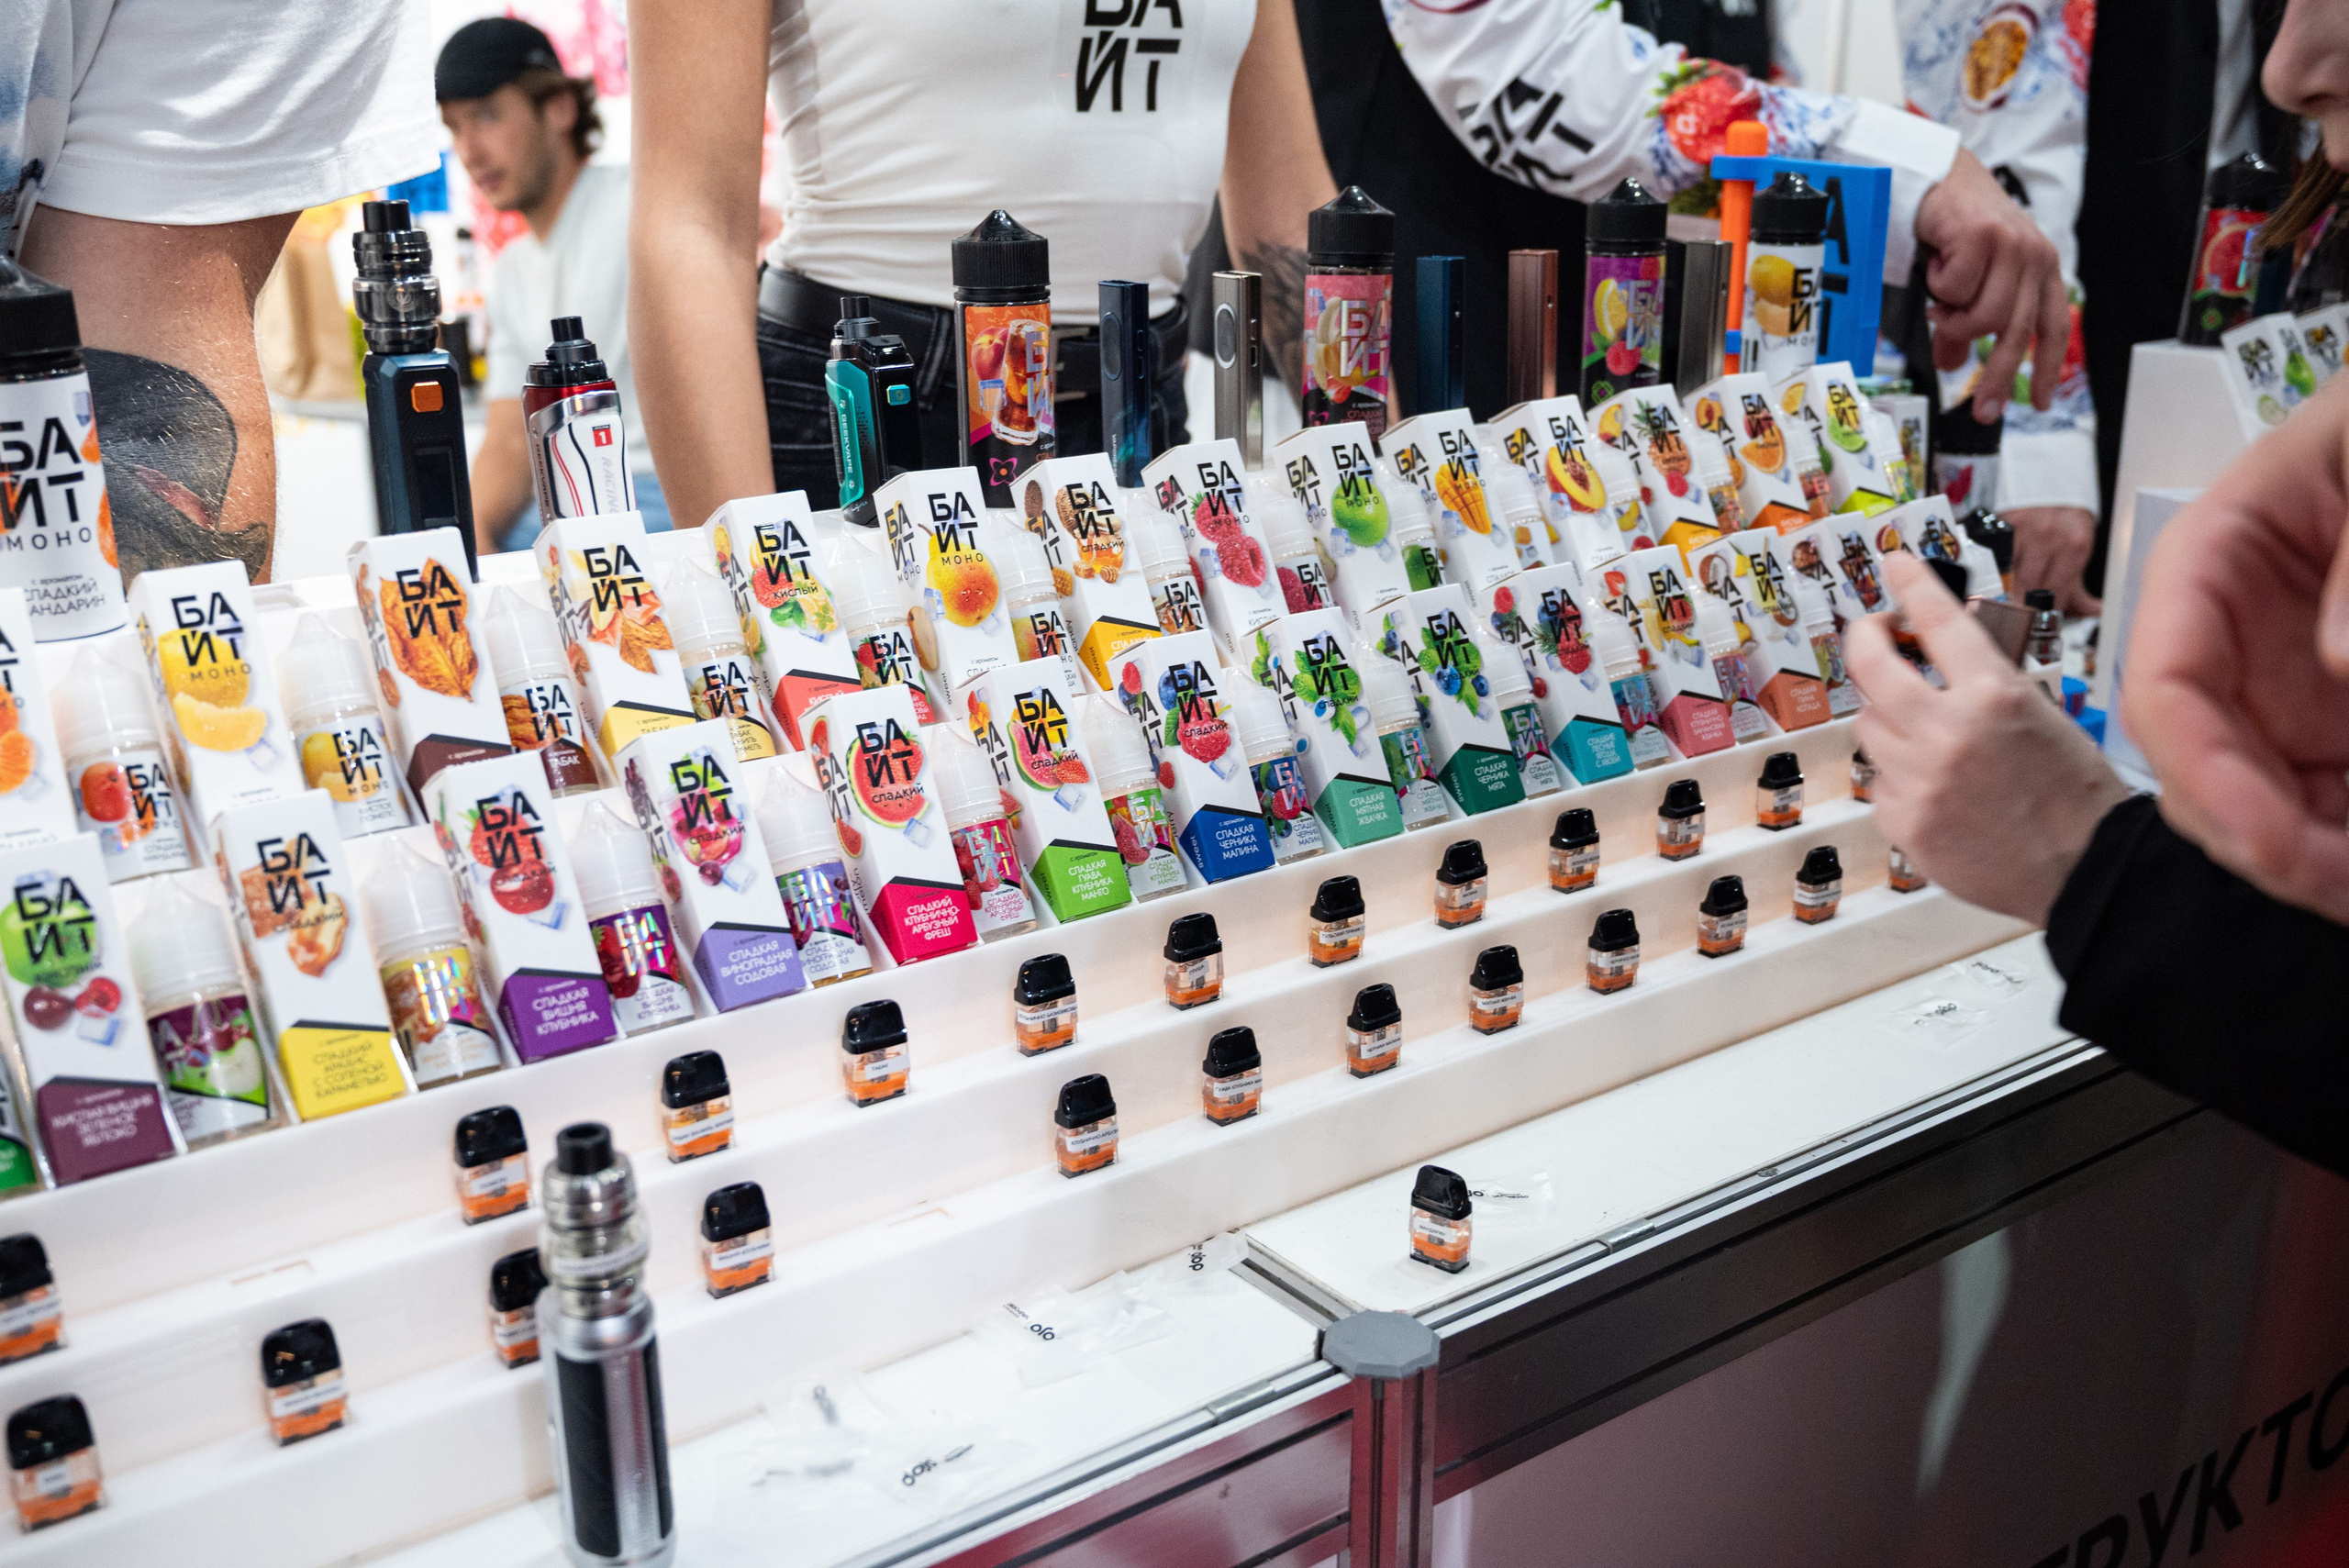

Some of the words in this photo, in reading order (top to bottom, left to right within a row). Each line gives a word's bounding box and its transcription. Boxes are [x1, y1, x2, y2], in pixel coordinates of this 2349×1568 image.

[1548, 415, 1584, 440] БА
[841, 414, 853, 474] GEEKVAPE
[1438, 428, 1475, 456] БА
[1331, 443, 1371, 470] БА
[1197, 460, 1241, 489] БА
[1066, 481, 1112, 510] БА
[928, 492, 976, 522] БА
[1214, 514, 1251, 528] МОНО
[6, 527, 92, 550] МОНО
[753, 520, 809, 553] БА
[1081, 538, 1125, 553] сладкий
[941, 552, 985, 565] МОНО
[773, 582, 819, 600] кислый
[1648, 568, 1685, 596] БА
[29, 595, 106, 617] АНДАРИН
[1542, 588, 1579, 617] БА
[1427, 611, 1468, 641] БА
[1302, 636, 1347, 667] БА
[189, 663, 252, 682] МОНО
[1168, 661, 1216, 693] БА
[1014, 687, 1065, 722] БА
[855, 718, 912, 754] БА
[1184, 719, 1230, 739] сладкий
[1030, 749, 1080, 770] сладкий
[1474, 760, 1508, 777] СЛАДКАЯ
[1476, 770, 1510, 786] ЧЕРНИКА
[1487, 780, 1508, 793] МЯТА
[871, 783, 926, 804] сладкий
[1350, 791, 1386, 808] СЛАДКАЯ
[1356, 811, 1389, 827] ЖВАЧКА
[1215, 823, 1255, 840] СЛАДКАЯ
[1219, 833, 1258, 851] ЧЕРНИКА
[1222, 844, 1260, 861] МАЛИНА
[1068, 859, 1108, 876] СЛАДКАЯ
[1077, 869, 1103, 883] ГУАВА
[1072, 876, 1114, 895] КЛУБНИКА
[1081, 887, 1110, 901] МАНГО
[907, 895, 954, 916] СЛАДКИЙ
[911, 916, 960, 936] АРБУЗНЫЙ
[924, 927, 952, 941] ФРЕШ
[728, 940, 780, 962] СЛАДКАЯ
[734, 962, 787, 986] СОДОВАЯ
